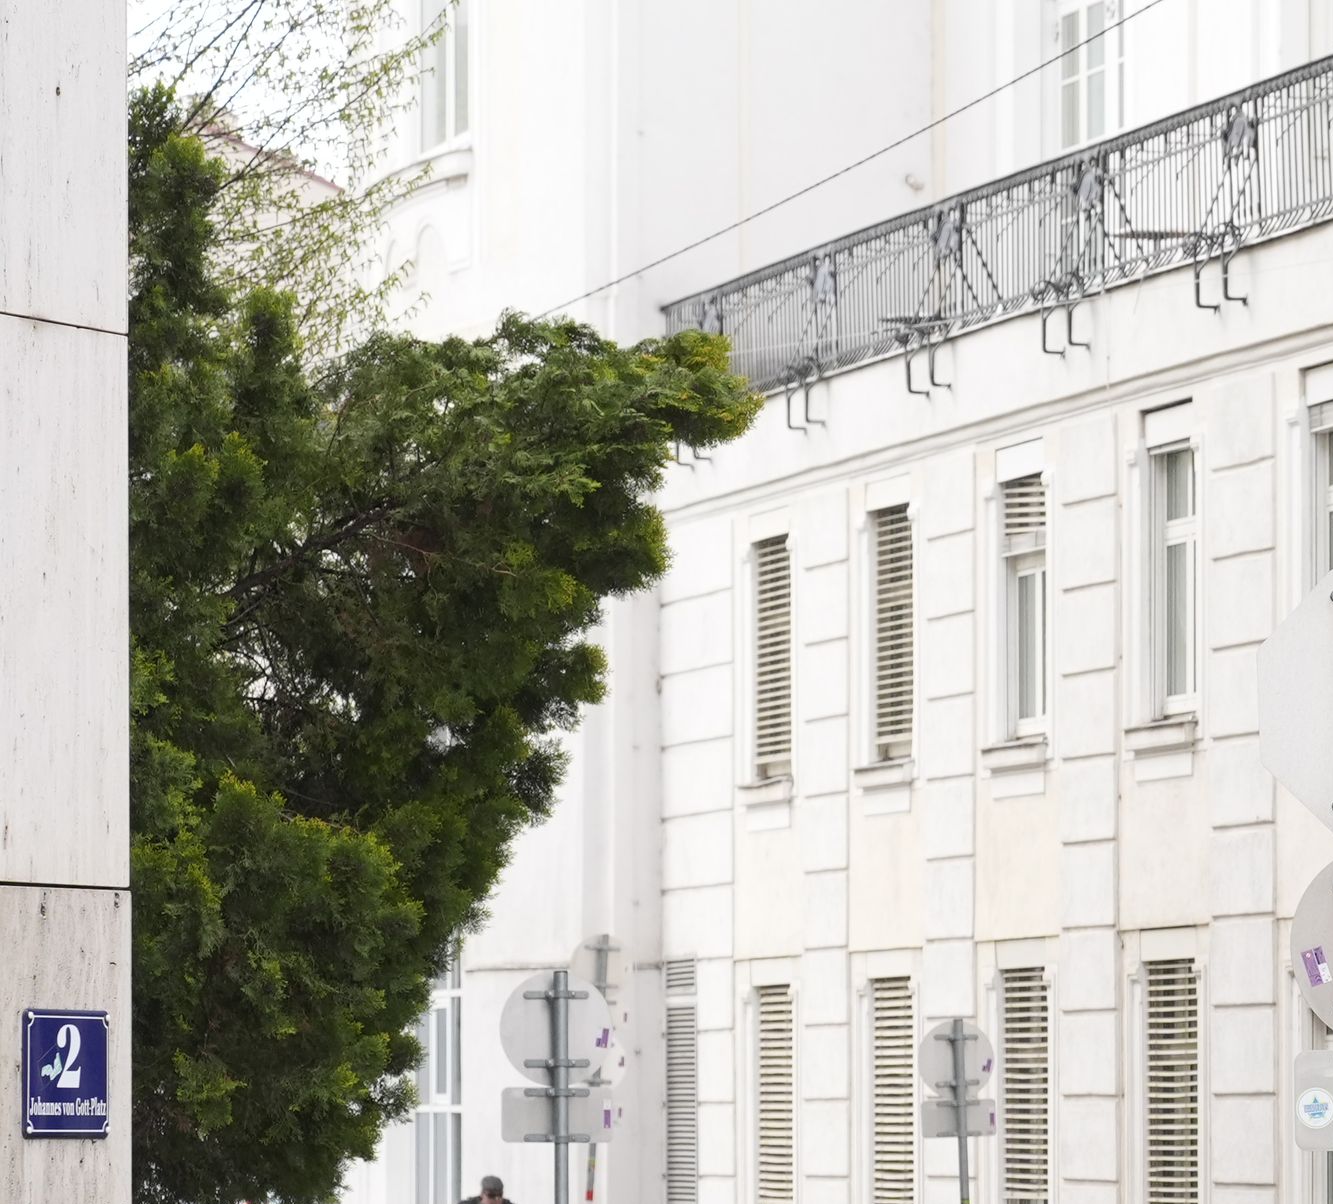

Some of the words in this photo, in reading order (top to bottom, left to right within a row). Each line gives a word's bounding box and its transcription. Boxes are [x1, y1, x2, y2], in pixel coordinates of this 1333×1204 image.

[57, 1024, 81, 1088] 2
[30, 1096, 61, 1116] Johannes
[63, 1102, 75, 1116] von
